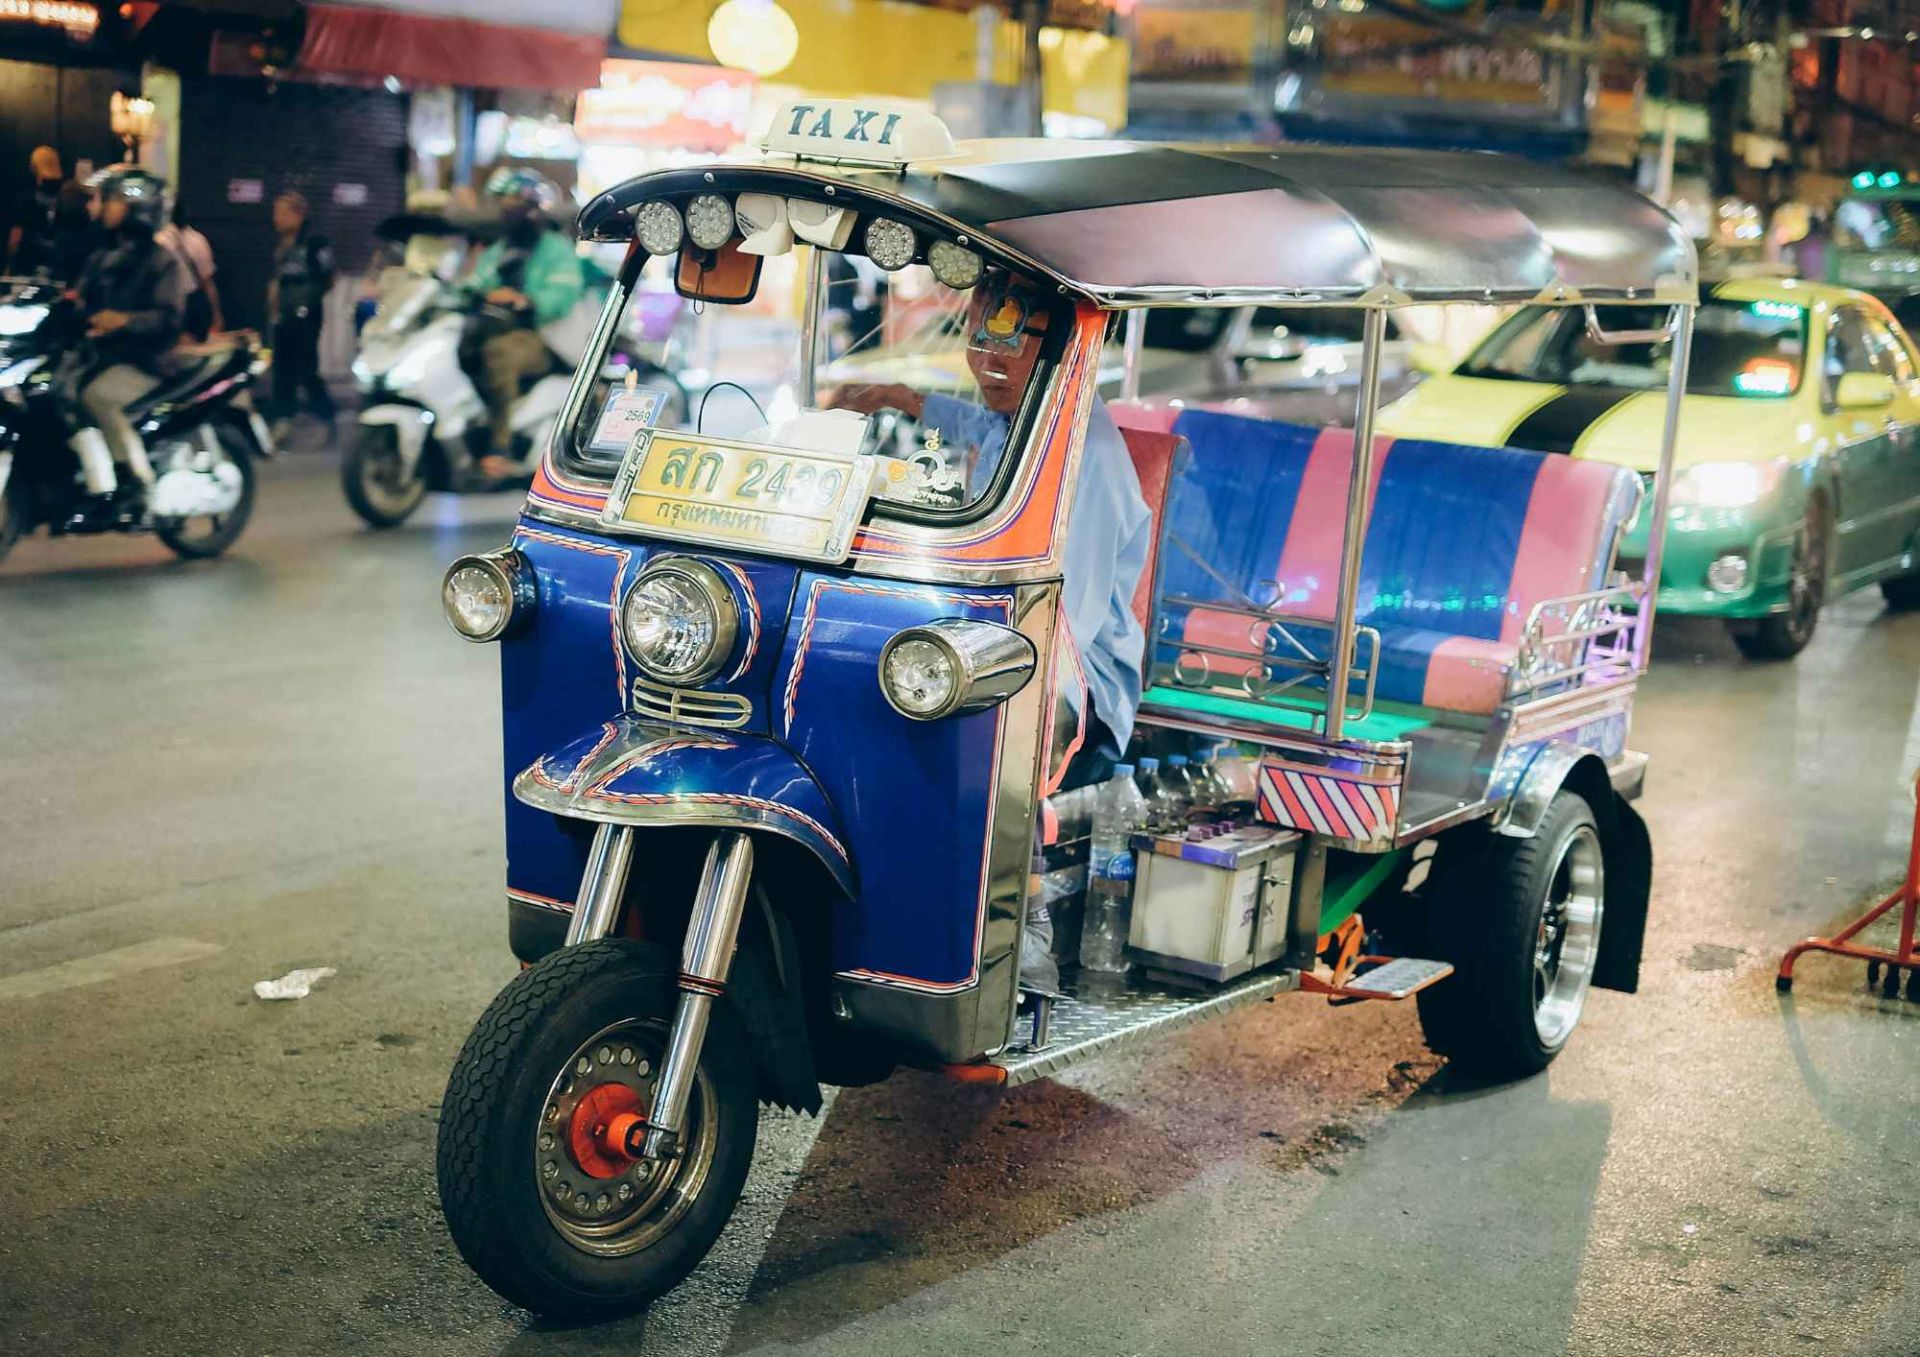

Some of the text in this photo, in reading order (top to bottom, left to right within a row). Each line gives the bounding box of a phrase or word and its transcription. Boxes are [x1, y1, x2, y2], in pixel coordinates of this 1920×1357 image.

[787, 105, 902, 145] TAXI
[624, 408, 651, 423] 2569
[660, 445, 724, 493] สก
